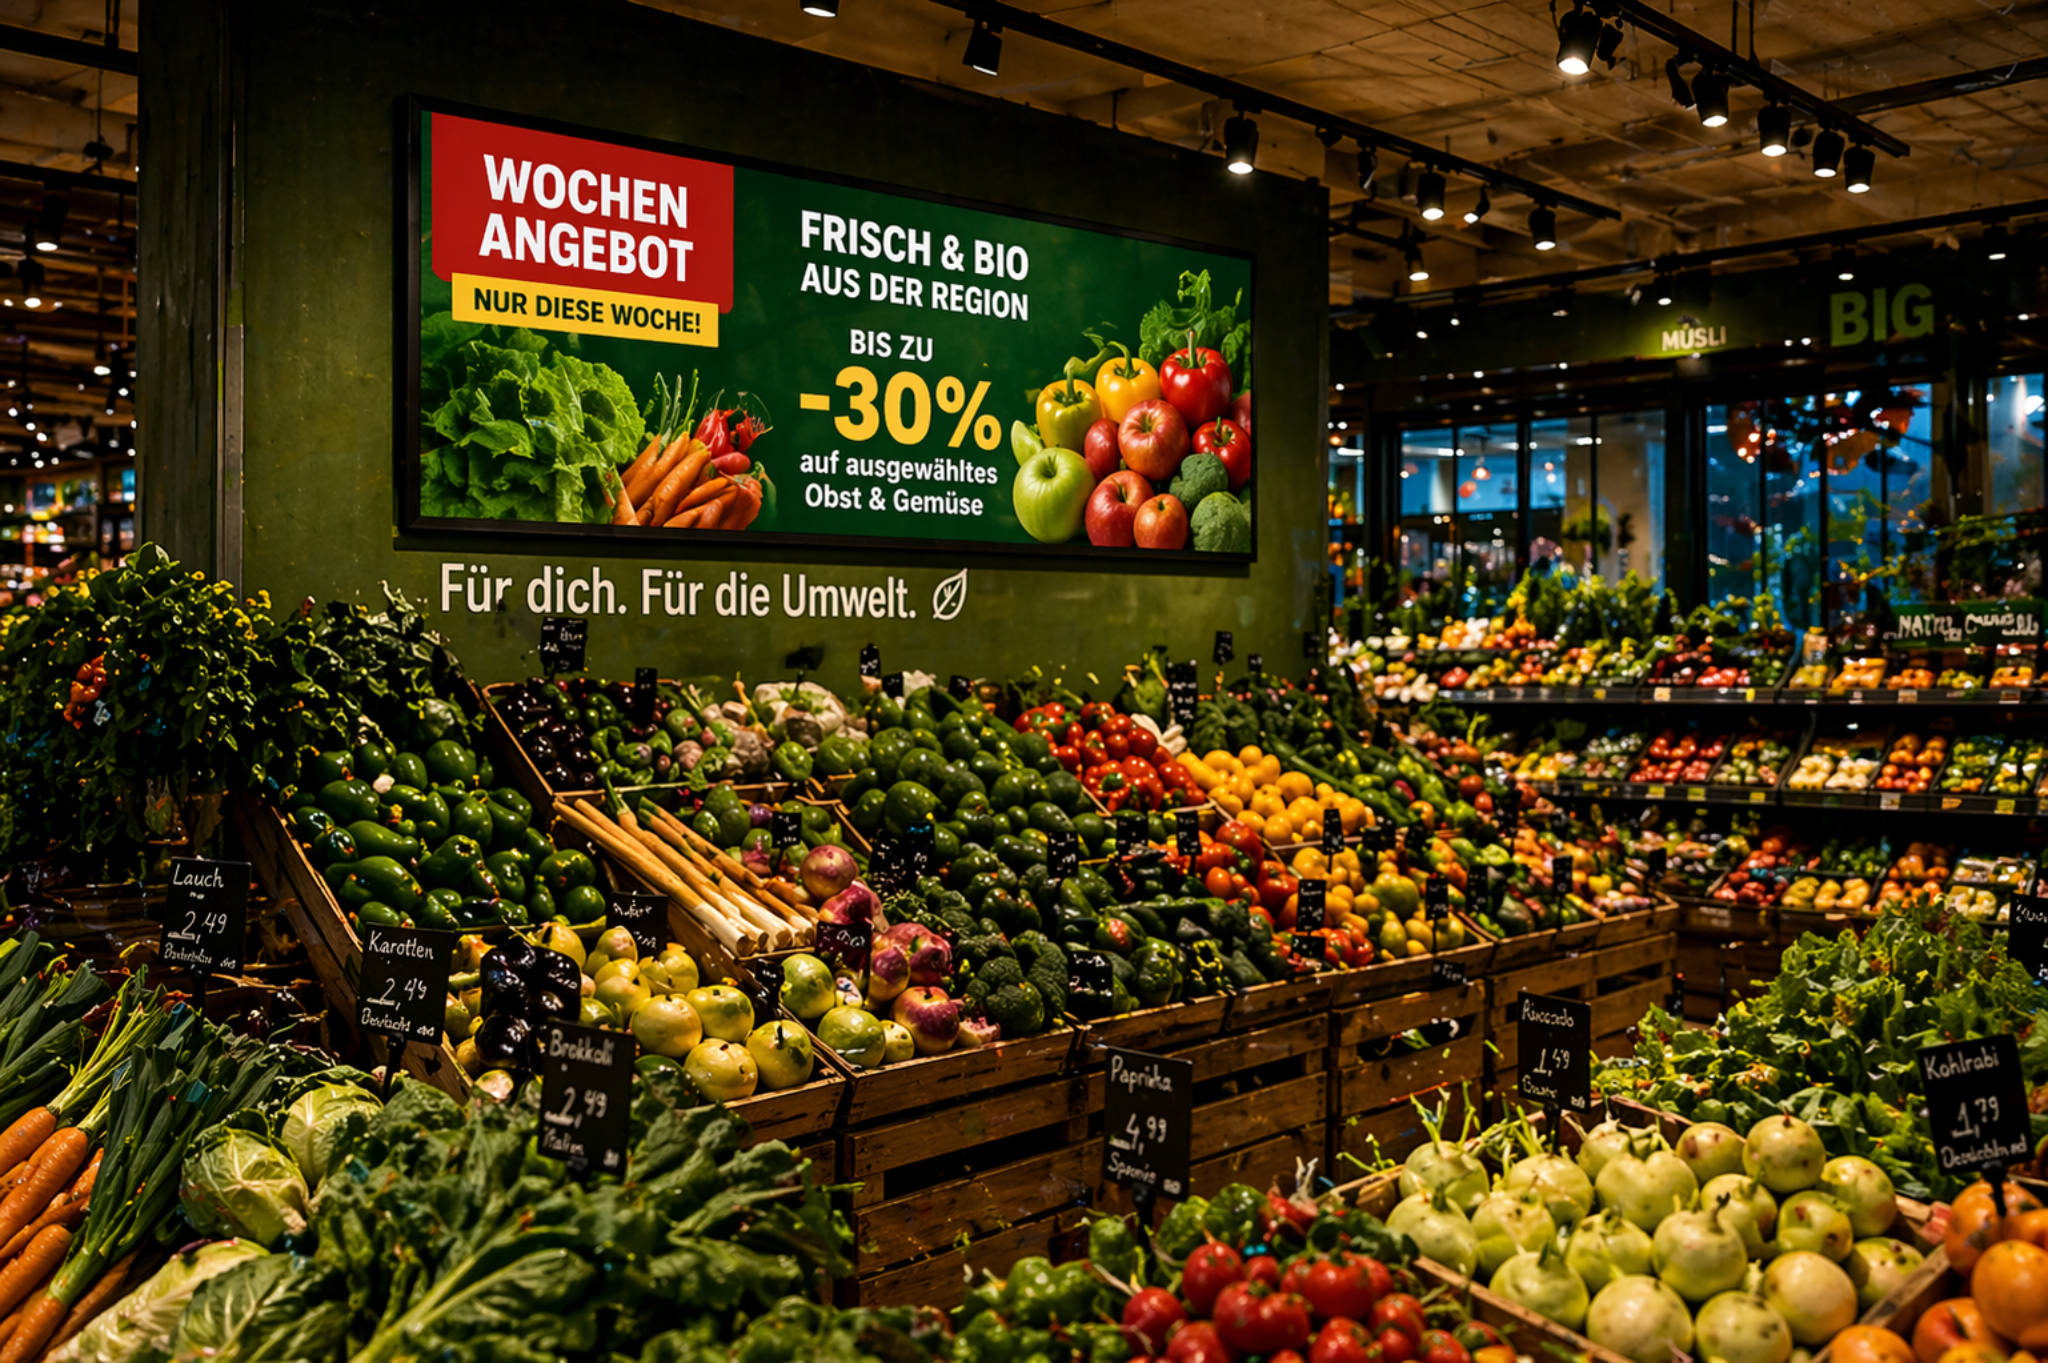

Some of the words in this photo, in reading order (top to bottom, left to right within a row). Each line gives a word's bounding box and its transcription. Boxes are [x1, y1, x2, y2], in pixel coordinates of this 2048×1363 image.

[483, 153, 688, 229] WOCHEN
[478, 212, 694, 282] ANGEBOT
[801, 210, 932, 267] FRISCH
[940, 234, 966, 272] &
[974, 239, 1029, 281] BIO
[474, 287, 528, 315] NUR
[536, 295, 604, 324] DIESE
[610, 303, 702, 335] WOCHE!
[800, 262, 861, 298] AUS
[869, 272, 923, 307] DER
[931, 280, 1029, 321] REGION
[1661, 324, 1727, 351] MÜSLI
[1829, 282, 1935, 348] BIG
[850, 328, 892, 358] BIS
[899, 334, 933, 362] ZU
[800, 366, 1002, 451] -30%
[800, 449, 840, 475] auf
[845, 454, 998, 493] ausgewähltes
[804, 482, 862, 510] Obst
[868, 486, 887, 511] &
[893, 488, 984, 516] Gemüse
[441, 563, 513, 613] Für
[527, 565, 627, 614] dich.
[642, 568, 704, 616] Für
[715, 571, 771, 617] die
[783, 573, 917, 619] Umwelt.
[172, 862, 225, 888] Lauch
[168, 910, 228, 945] 2,49
[368, 929, 434, 960] Karotten
[1923, 1044, 2000, 1081] Kohlrabi
[1109, 1112, 1168, 1157] 4,99
